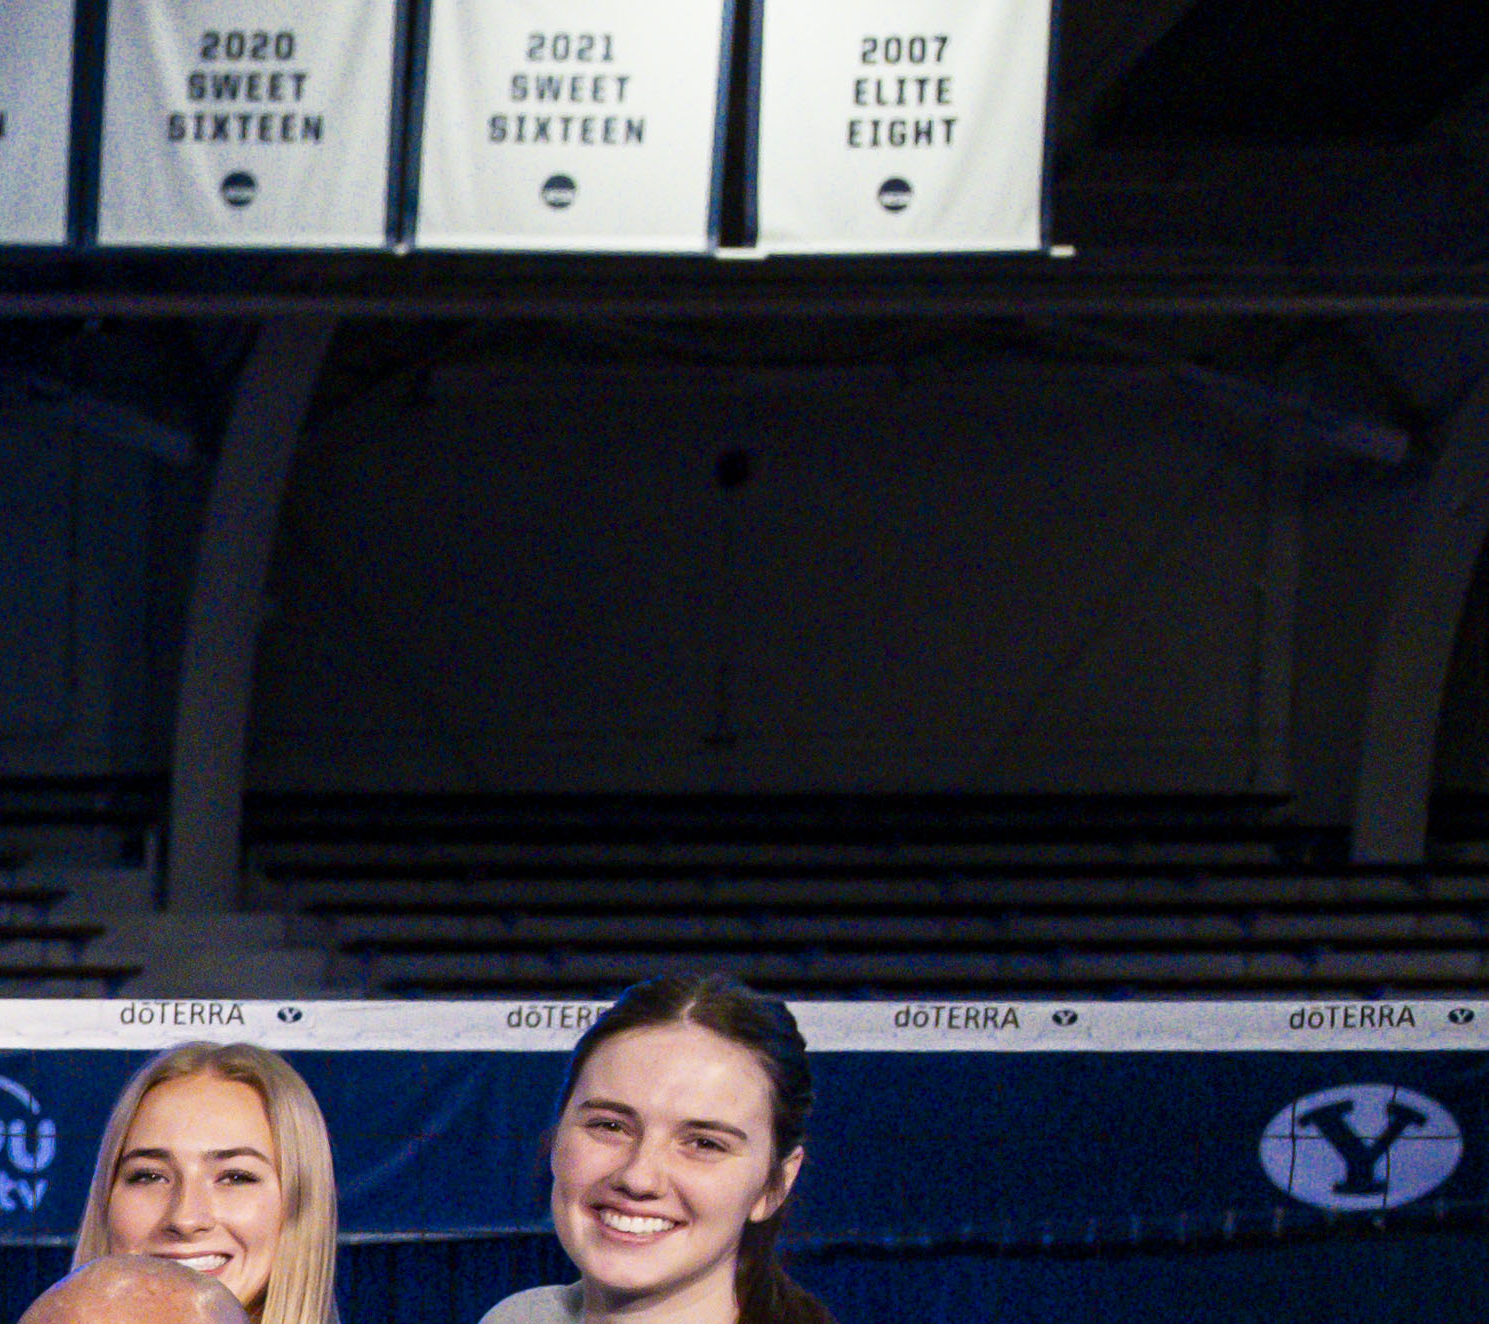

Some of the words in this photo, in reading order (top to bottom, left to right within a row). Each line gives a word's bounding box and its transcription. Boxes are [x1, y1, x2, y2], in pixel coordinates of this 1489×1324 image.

[200, 31, 294, 61] 2020
[526, 33, 613, 62] 2021
[861, 35, 948, 64] 2007
[188, 71, 306, 101] SWEET
[511, 74, 629, 102] SWEET
[854, 77, 950, 106] ELITE
[166, 112, 322, 143] SIXTEEN
[488, 114, 644, 144] SIXTEEN
[848, 118, 956, 147] EIGHT
[506, 1004, 603, 1028] dōTER
[1298, 1099, 1427, 1194] Y
